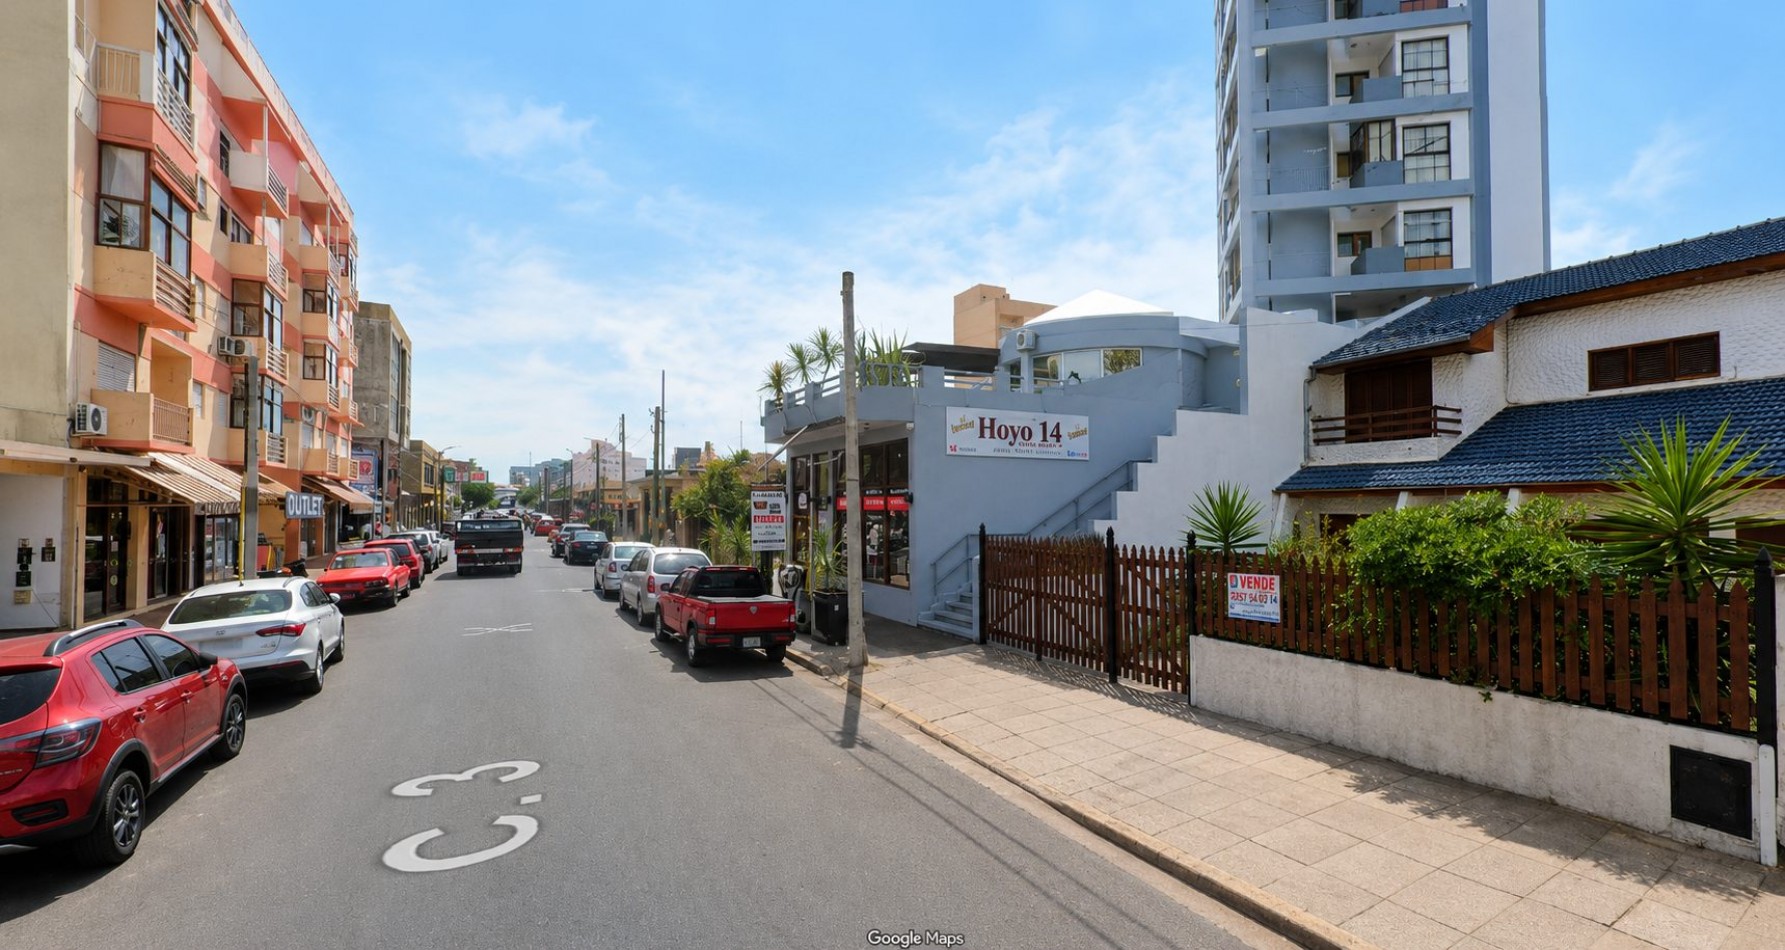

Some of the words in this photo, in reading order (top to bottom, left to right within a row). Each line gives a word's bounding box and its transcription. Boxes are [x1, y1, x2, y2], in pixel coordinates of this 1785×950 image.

[978, 416, 1032, 446] Hoyo
[1039, 421, 1062, 443] 14
[288, 494, 323, 516] OUTLET
[1240, 575, 1275, 591] VENDE
